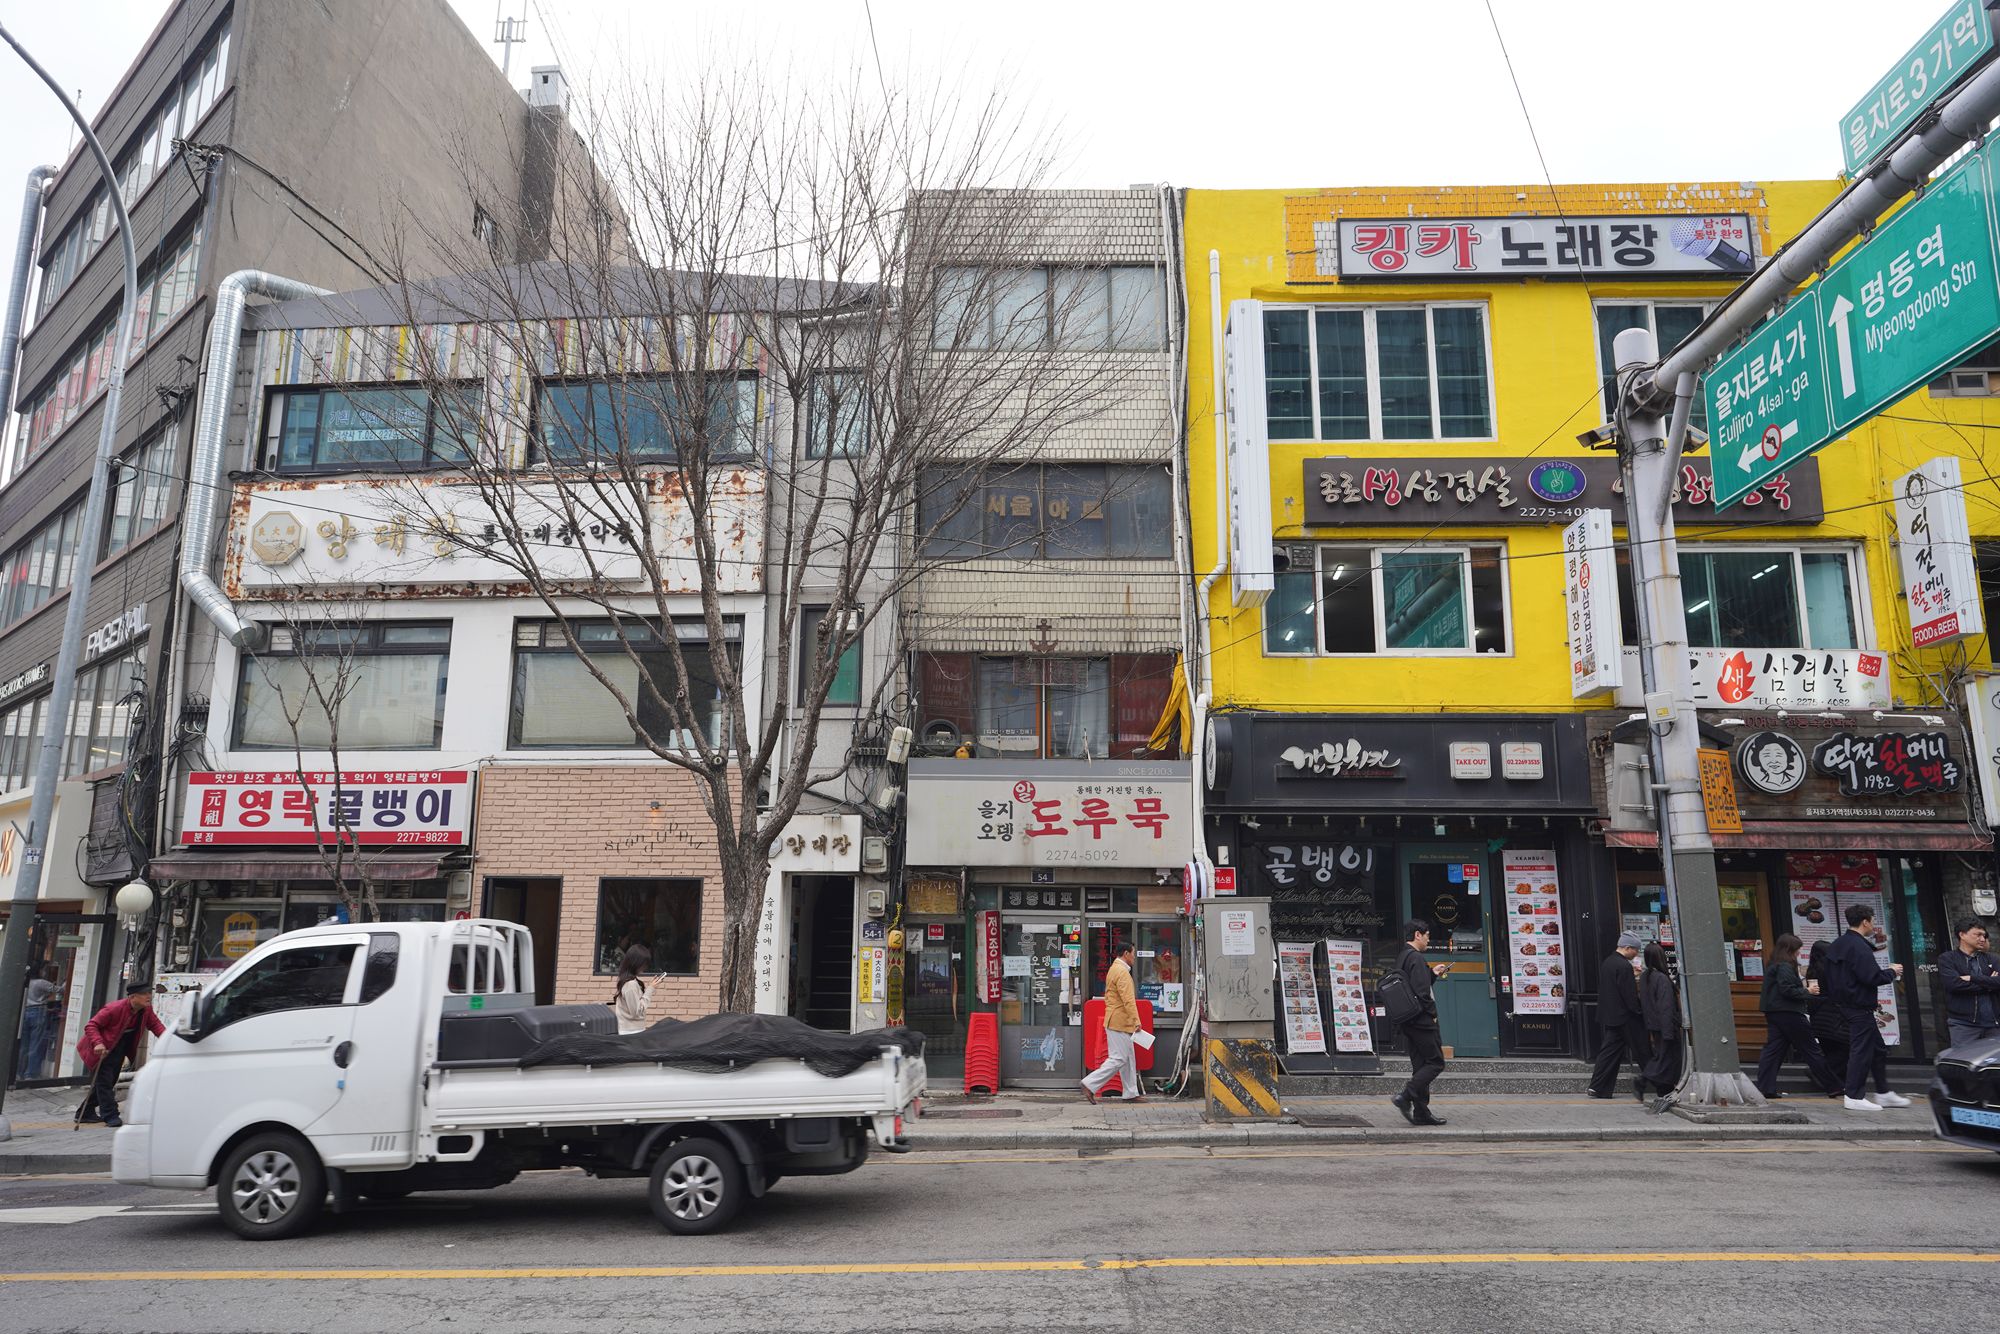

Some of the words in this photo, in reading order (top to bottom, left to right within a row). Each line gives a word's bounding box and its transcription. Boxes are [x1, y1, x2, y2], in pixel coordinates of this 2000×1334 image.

[1850, 2, 1979, 161] 을지로3가역
[1694, 229, 1718, 240] 동반
[1720, 228, 1743, 240] 환영
[1703, 218, 1732, 229] 남·여
[1354, 223, 1481, 270] 킹카
[1501, 223, 1658, 267] 노래장
[1860, 223, 1945, 318] 명동역
[1865, 278, 1949, 354] Myeongdong
[1951, 258, 1977, 294] Stn
[1715, 320, 1807, 422] 을지로4가
[1719, 409, 1754, 448] Euljiro
[985, 495, 1033, 518] 서울
[1520, 507, 1600, 517] 2275-40
[1911, 507, 1936, 574] 역전
[1722, 663, 1744, 701] 생
[1762, 652, 1849, 694] 삼겹살
[1118, 767, 1146, 776] SINCE
[1148, 767, 1173, 776] 2003
[1280, 738, 1400, 776] 깐부치킨
[1824, 737, 1878, 789] 역전
[1920, 761, 1959, 787] 맥주
[215, 773, 237, 783] 맛의
[243, 773, 265, 783] 원조
[354, 773, 377, 783] 역시
[384, 772, 442, 783] 영락골뱅이
[1014, 782, 1034, 801] 알
[1076, 785, 1102, 794] 동해안
[1107, 785, 1132, 795] 거진항
[1864, 774, 1895, 789] 1982
[204, 791, 222, 826] 元祖
[238, 789, 452, 827] 영락골뱅이
[977, 800, 1013, 819] 을지
[1025, 797, 1170, 839] 도루묵
[397, 832, 449, 842] 2277-9822
[977, 822, 1013, 842] 오뎅
[1046, 850, 1118, 861] 2274-5092
[1266, 846, 1372, 884] 골뱅이
[1038, 873, 1048, 881] 54
[864, 930, 882, 938] 54-1
[987, 916, 1000, 999] 정종대포
[1032, 968, 1049, 1005] 도루묵
